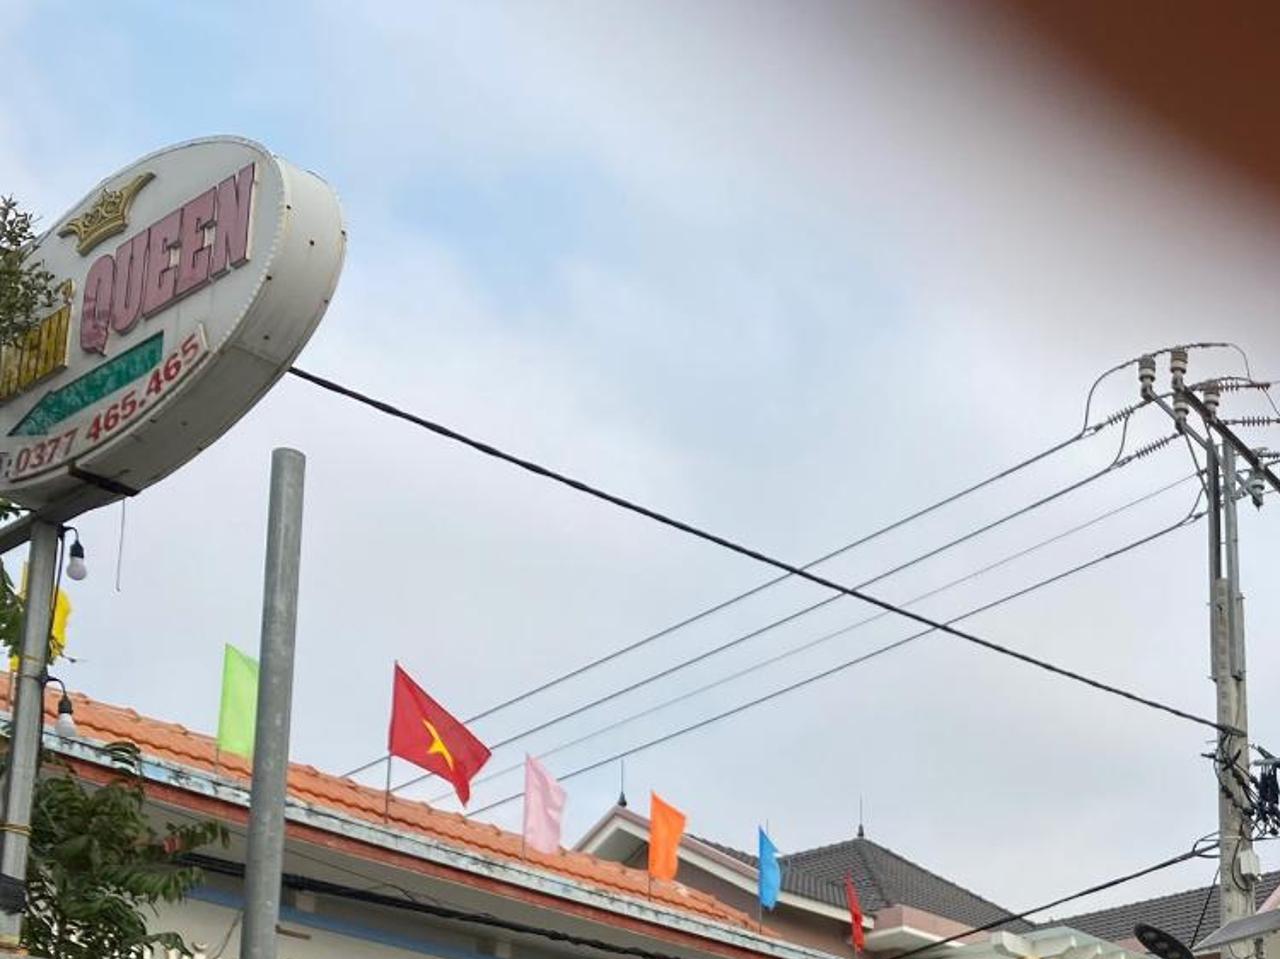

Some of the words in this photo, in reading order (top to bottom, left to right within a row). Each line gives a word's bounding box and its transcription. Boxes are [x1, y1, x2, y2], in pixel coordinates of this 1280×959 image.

[81, 162, 256, 355] QUEEN
[16, 427, 78, 473] 0377
[85, 333, 200, 442] 465.465
